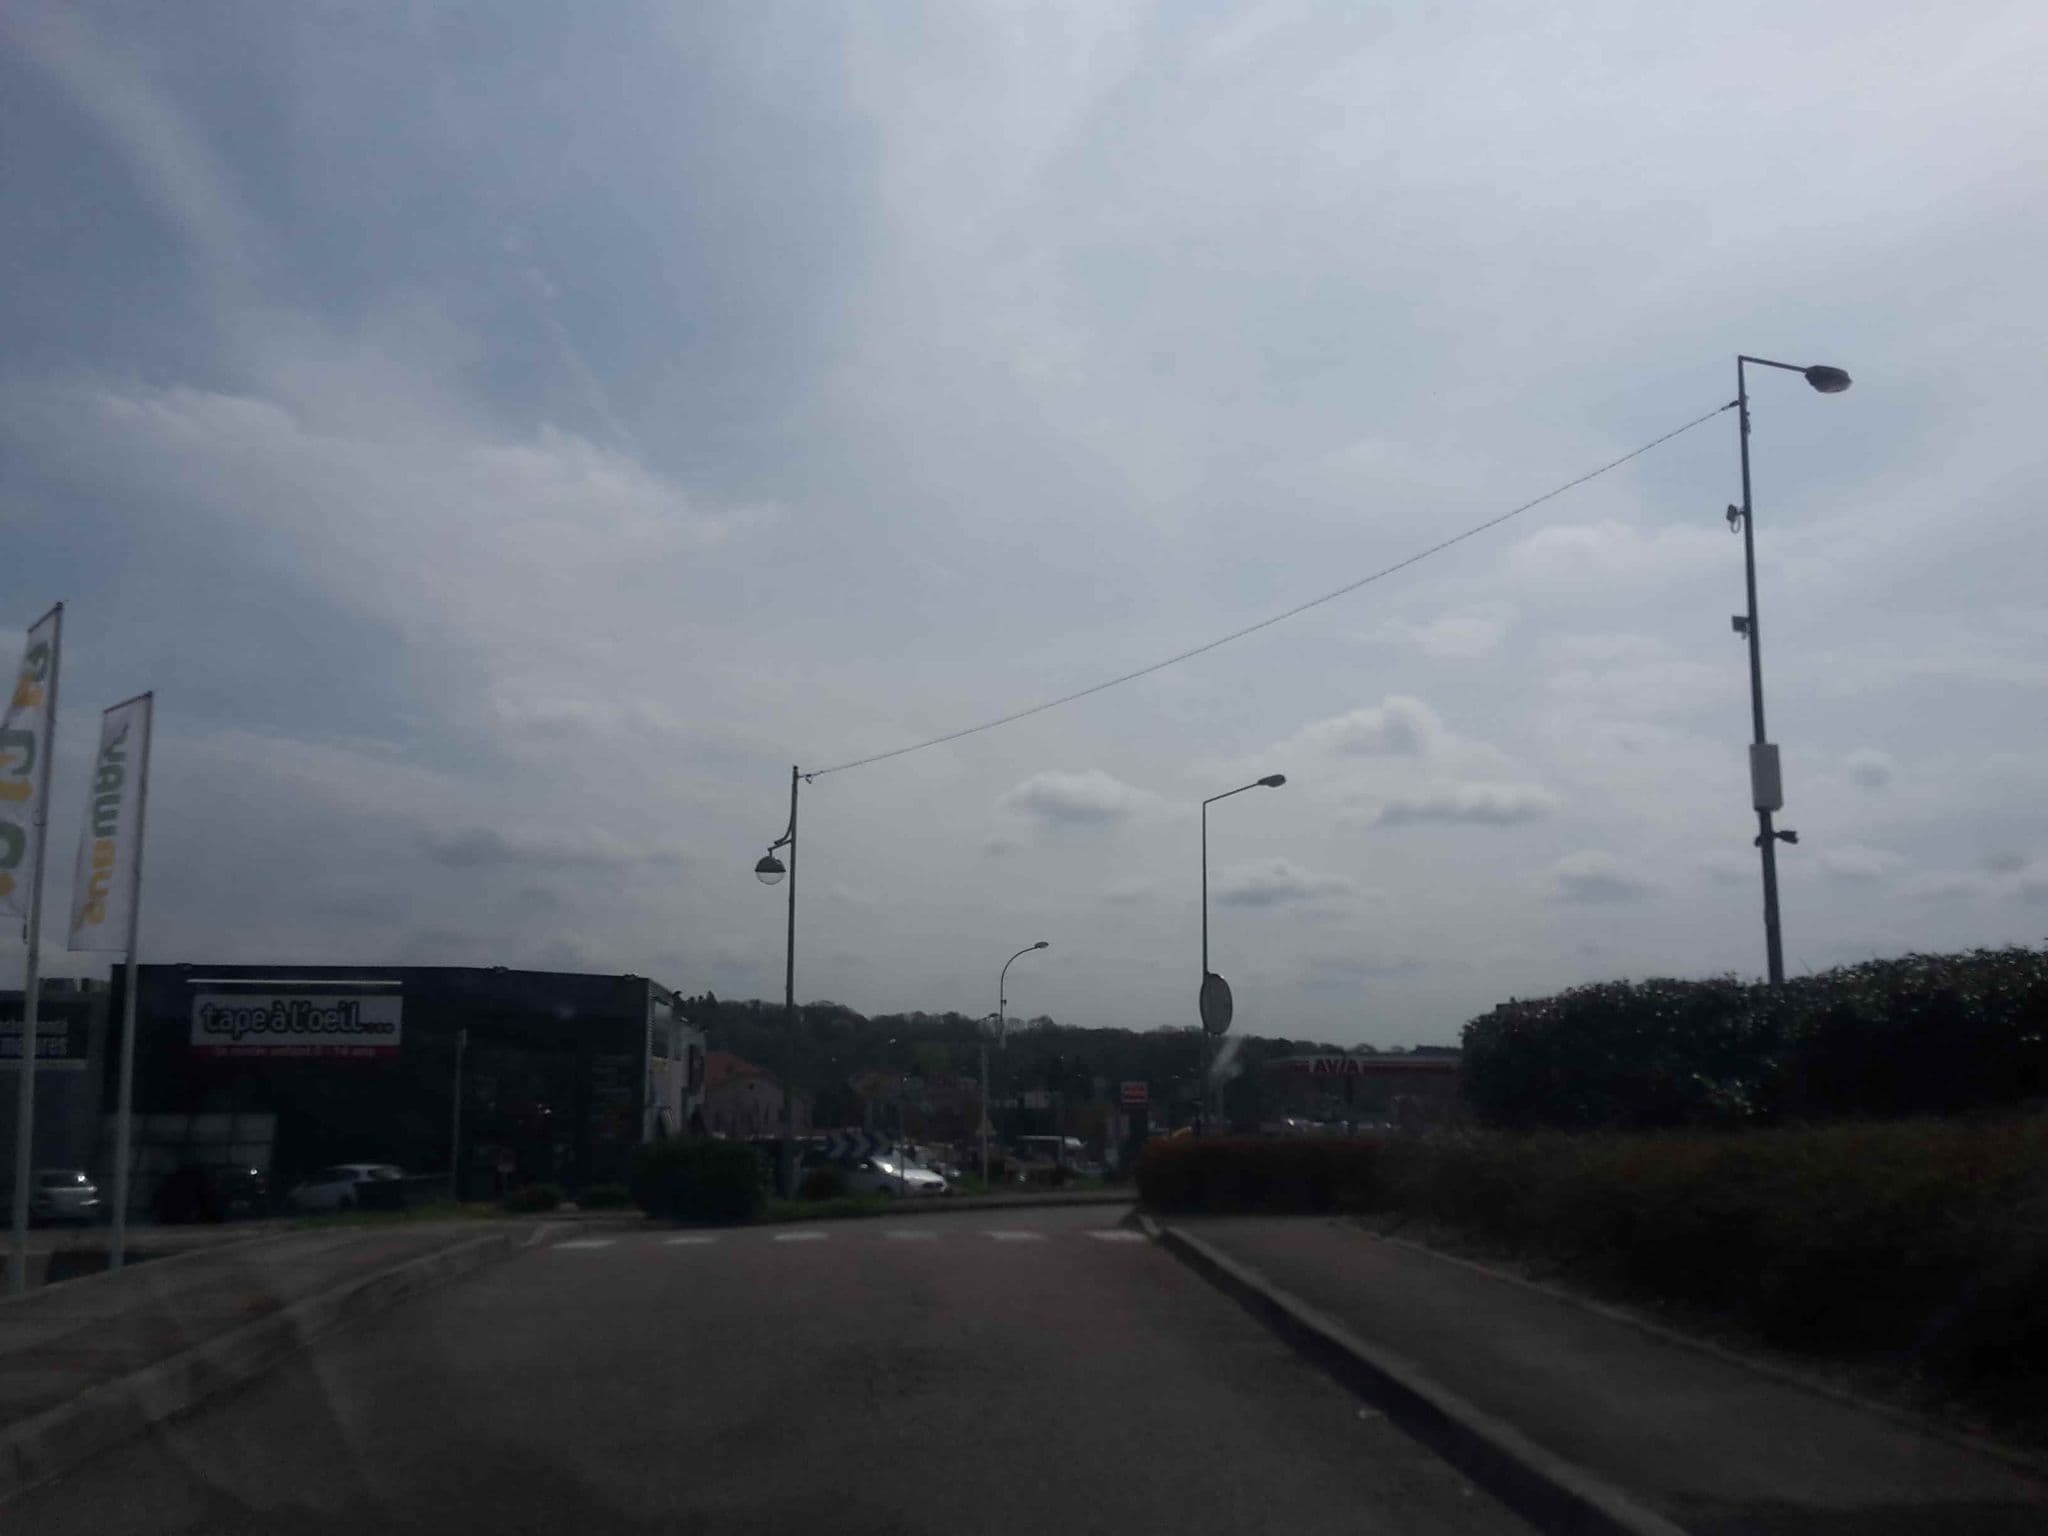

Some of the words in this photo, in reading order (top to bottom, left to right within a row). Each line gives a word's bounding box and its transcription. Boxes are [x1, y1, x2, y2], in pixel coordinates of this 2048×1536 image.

[202, 1002, 269, 1040] tape
[271, 1000, 288, 1033] à
[1312, 1058, 1362, 1075] AVIA
